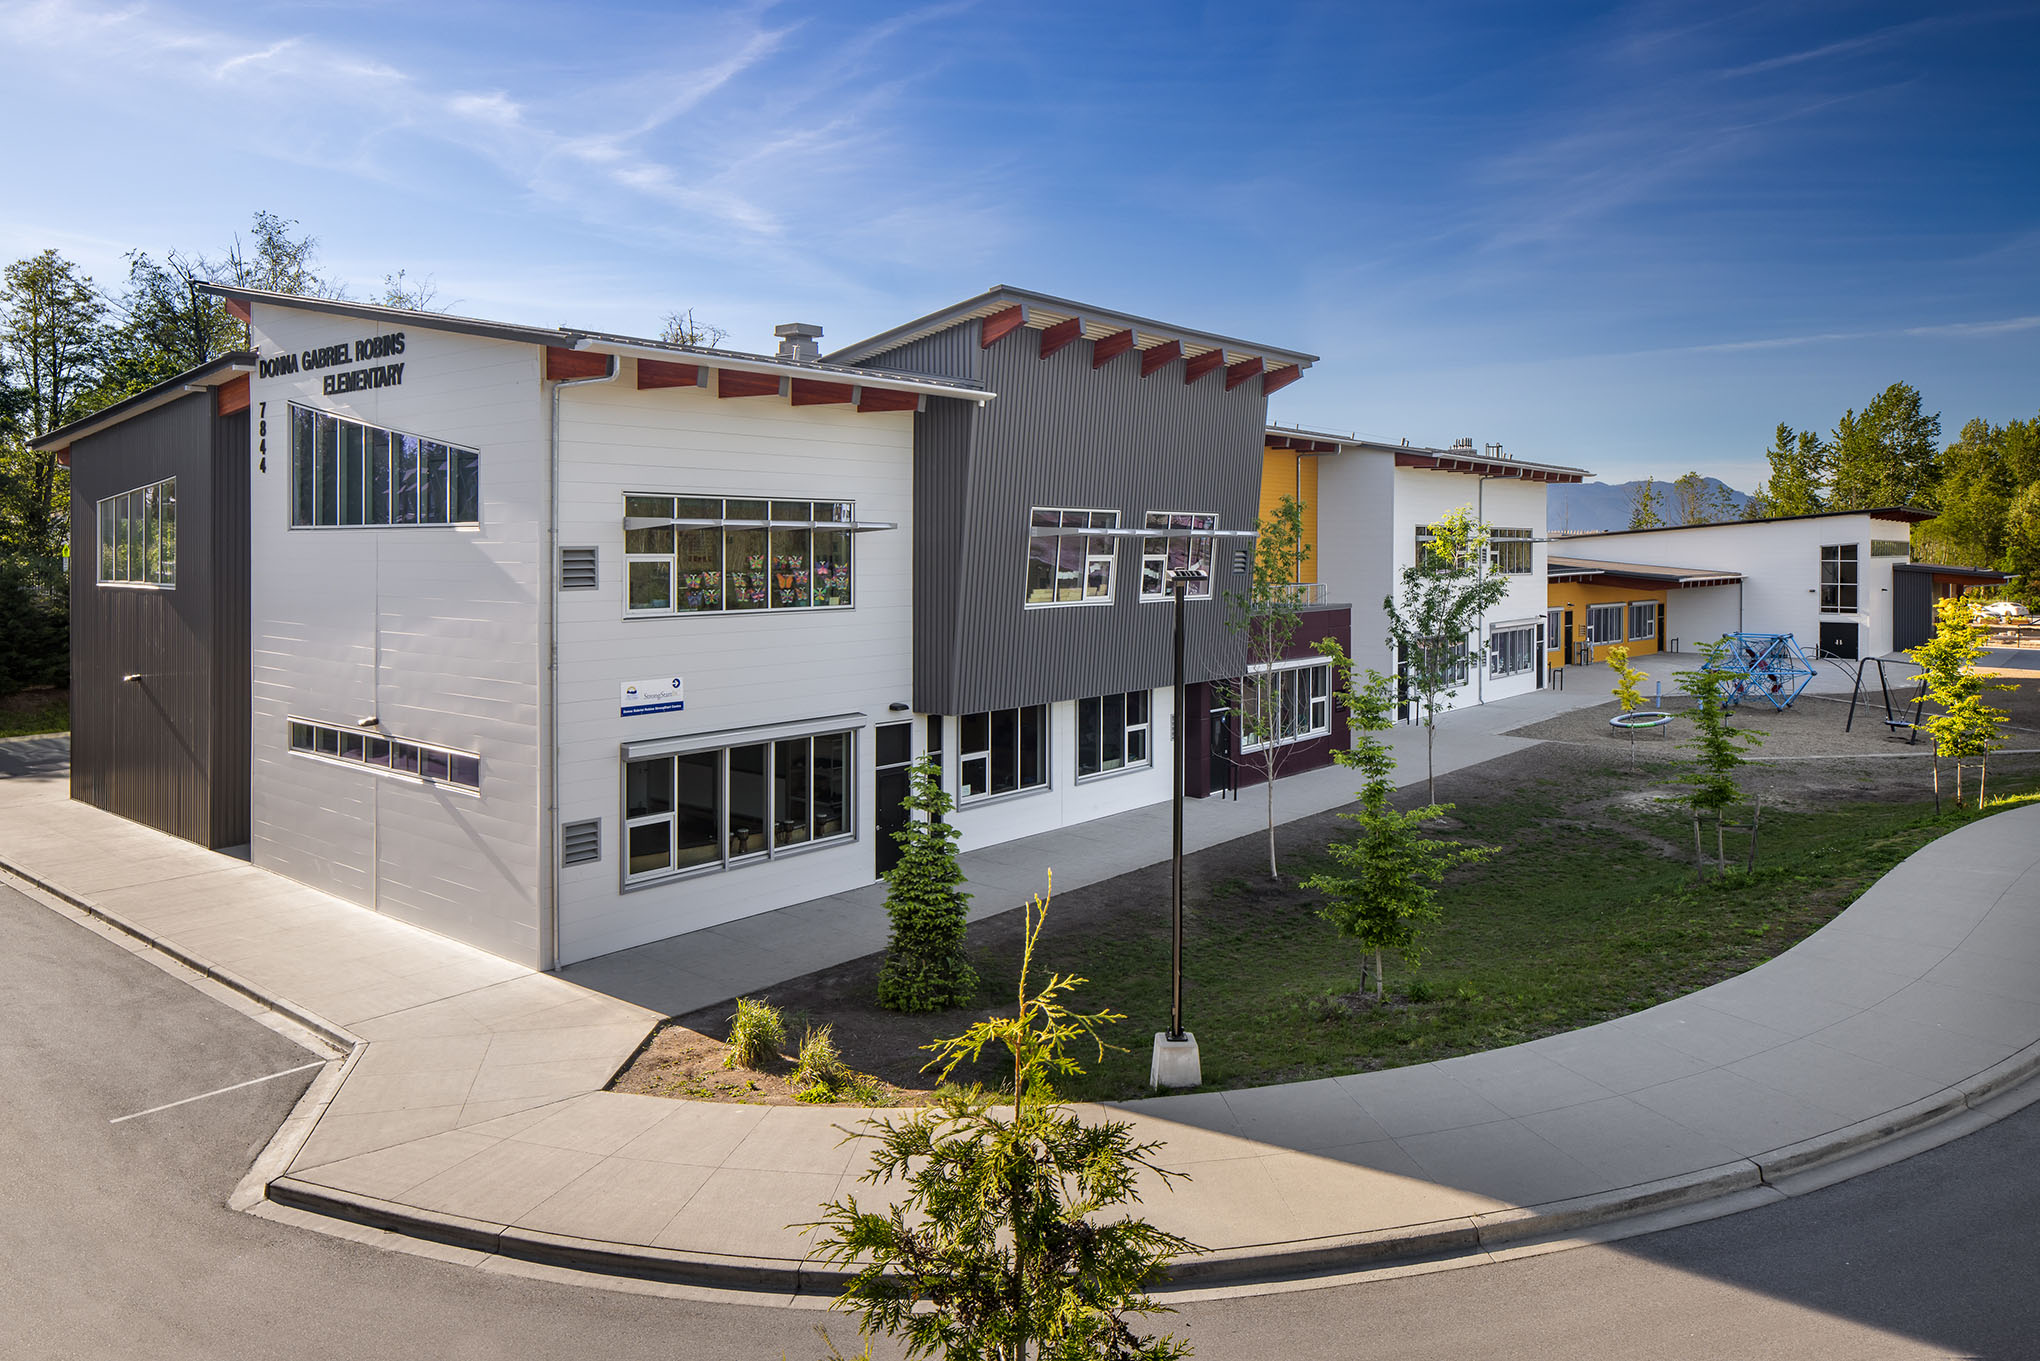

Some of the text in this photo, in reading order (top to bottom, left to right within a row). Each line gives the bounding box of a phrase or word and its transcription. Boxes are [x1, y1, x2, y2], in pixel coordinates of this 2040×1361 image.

[259, 332, 405, 379] DONNA GABRIEL ROBINS
[323, 362, 405, 396] ELEMENTARY
